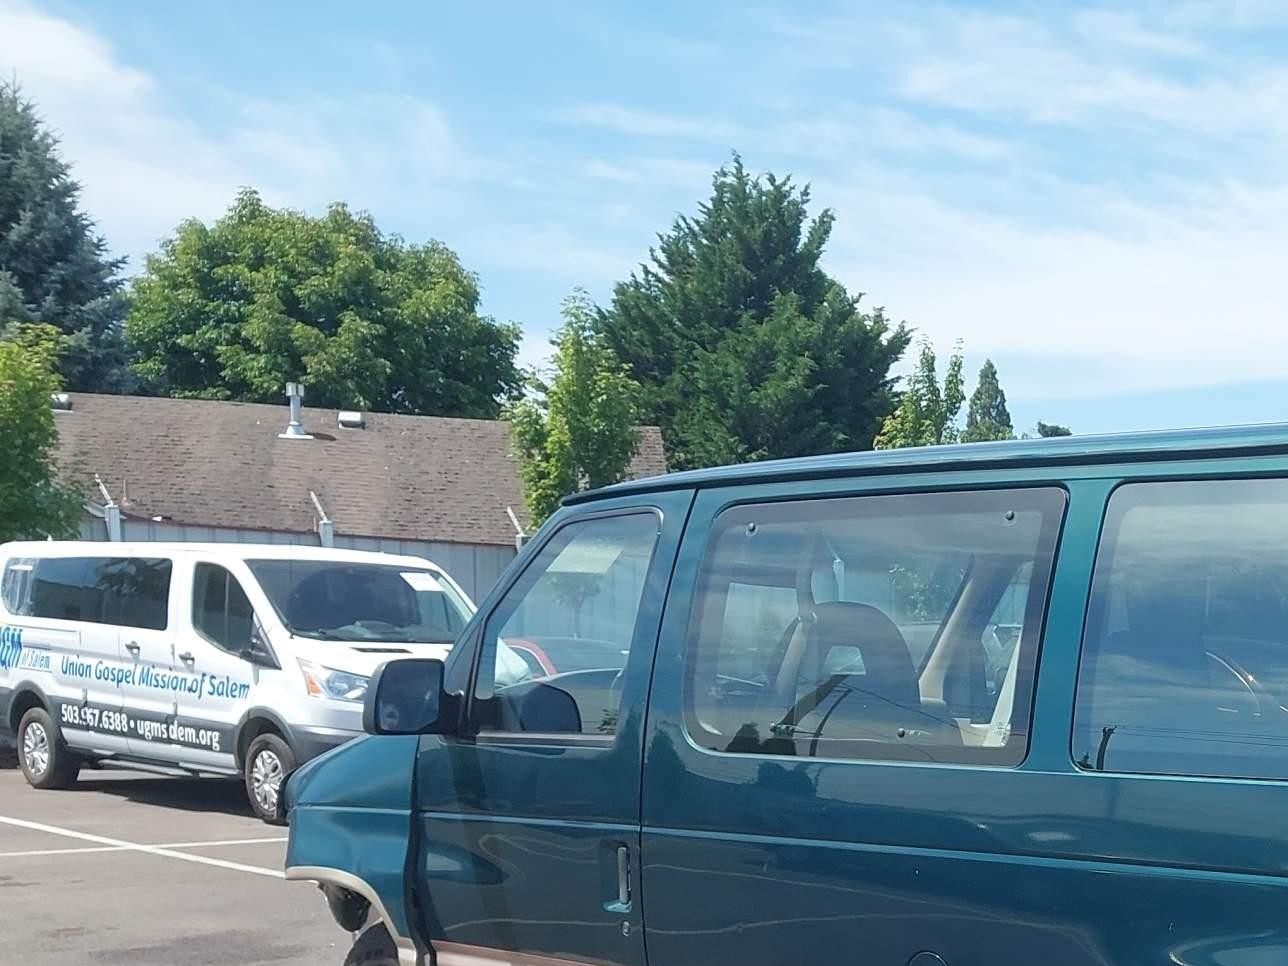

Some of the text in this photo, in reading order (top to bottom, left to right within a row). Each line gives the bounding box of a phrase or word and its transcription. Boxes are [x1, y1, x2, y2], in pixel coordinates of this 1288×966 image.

[0, 625, 23, 669] GM
[61, 655, 250, 700] Union Gospel Mission of Salem
[61, 703, 128, 733] 503.967.6388
